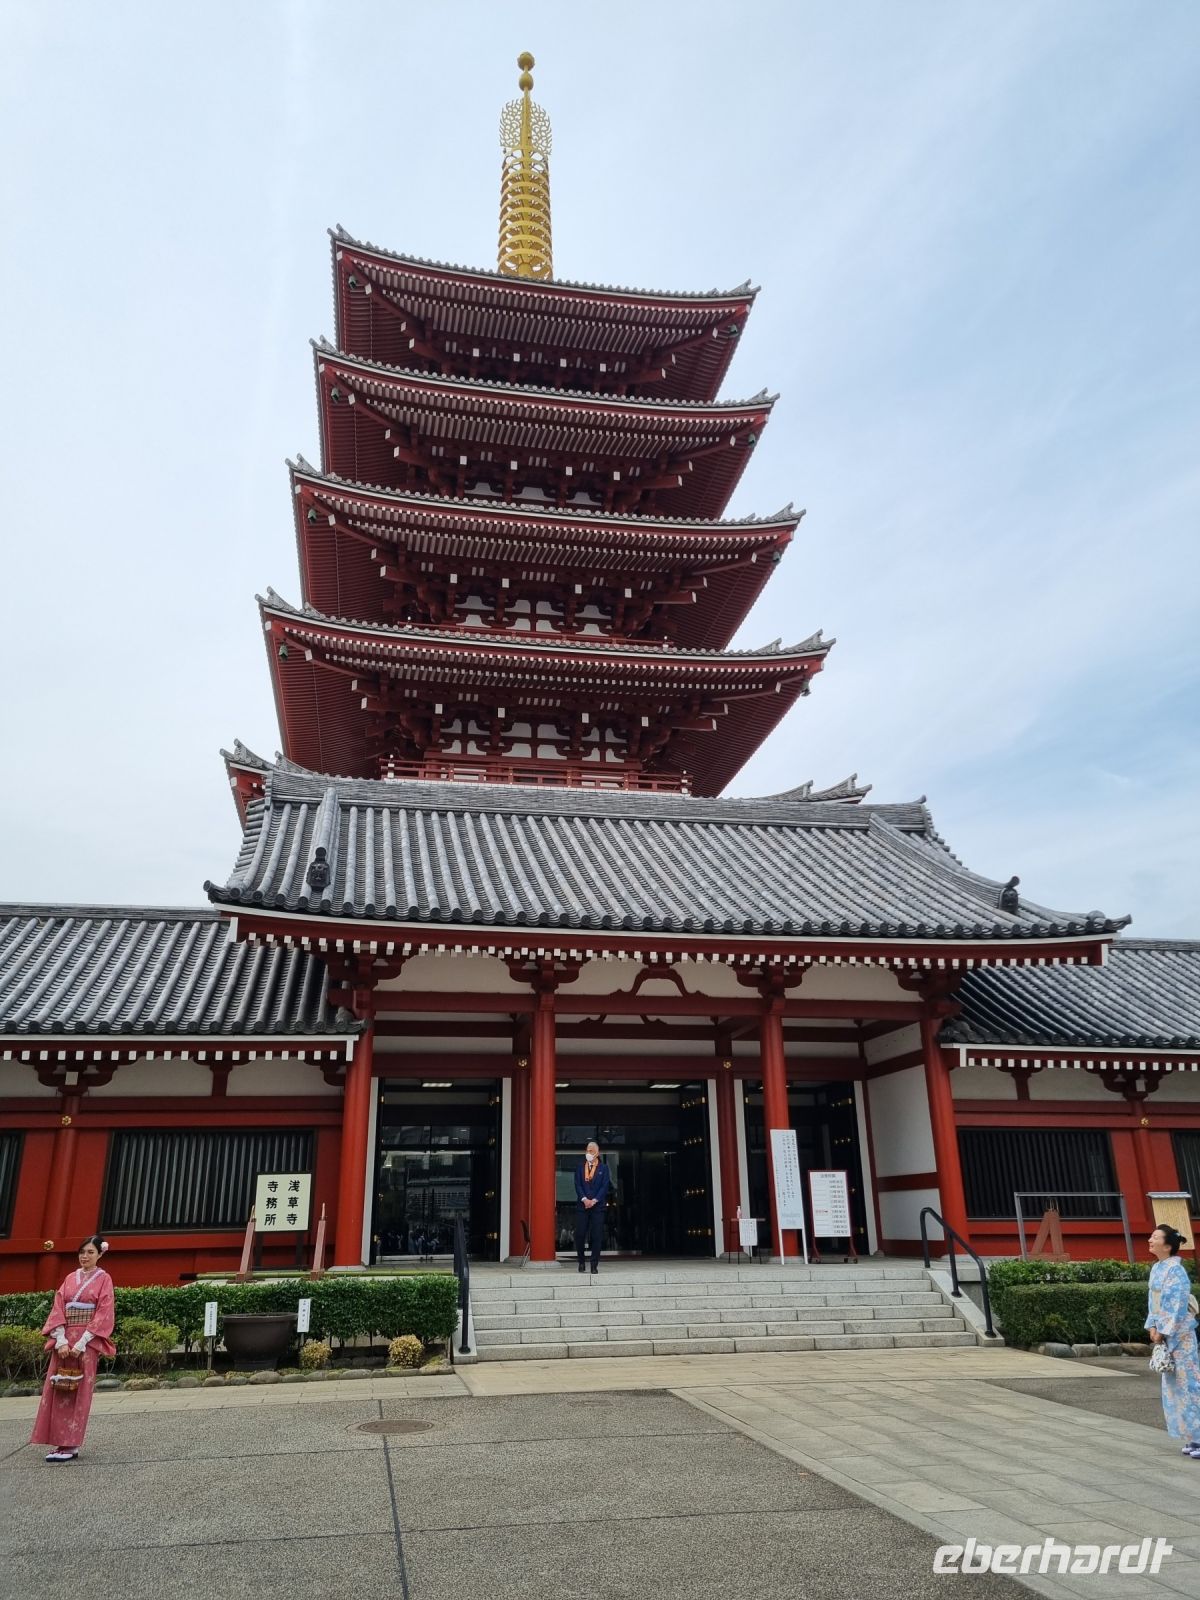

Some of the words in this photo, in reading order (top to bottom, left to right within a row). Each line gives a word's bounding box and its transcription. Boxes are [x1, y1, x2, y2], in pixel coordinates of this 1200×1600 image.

[264, 1181, 278, 1226] 寺務所
[286, 1180, 300, 1225] 浅草寺
